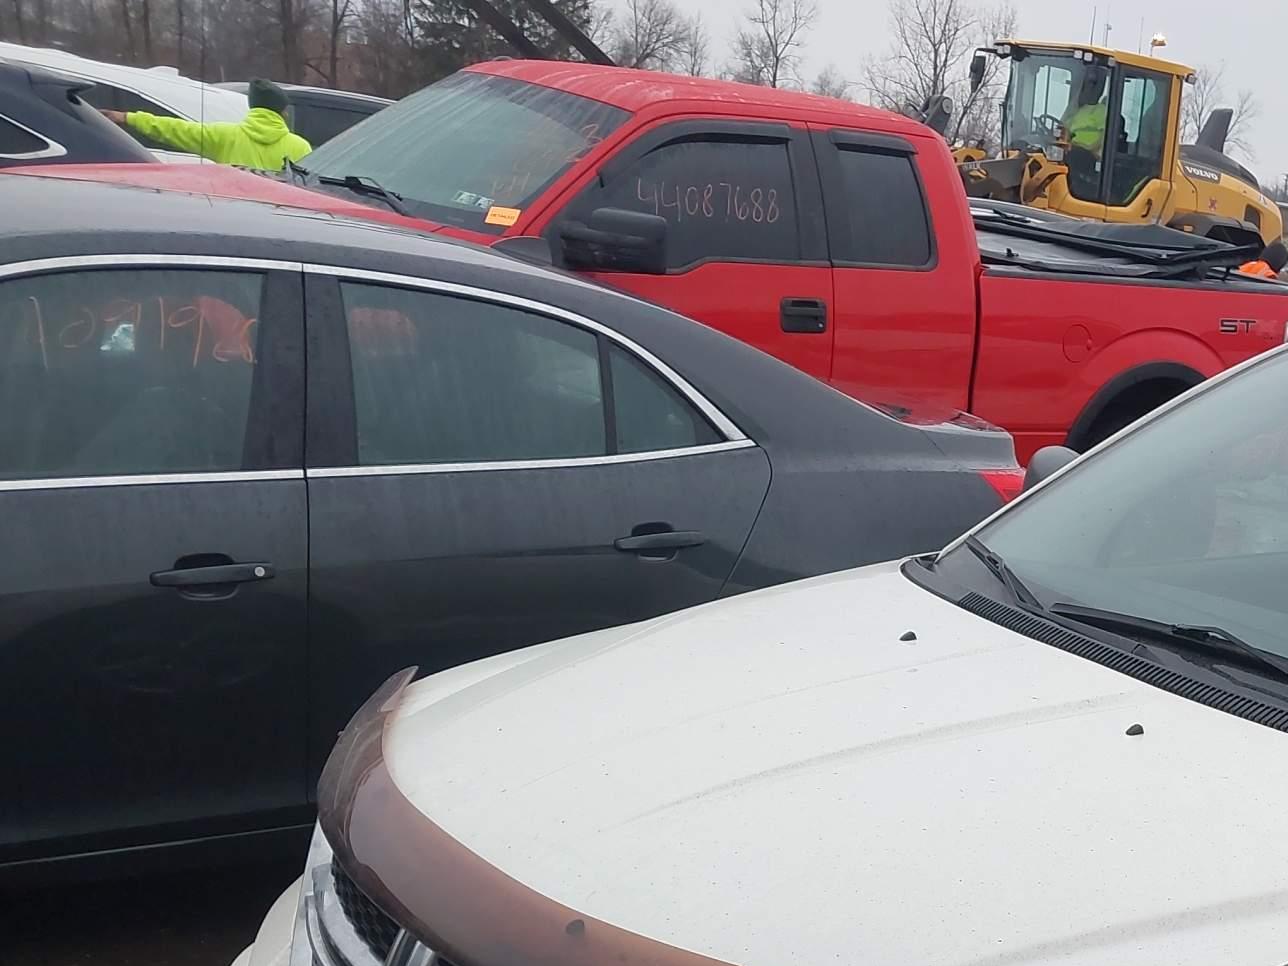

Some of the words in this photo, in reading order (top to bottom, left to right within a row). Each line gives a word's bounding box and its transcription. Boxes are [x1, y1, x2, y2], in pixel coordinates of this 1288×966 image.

[1184, 165, 1219, 180] VOLVO
[636, 176, 780, 223] 44087688
[1219, 318, 1257, 334] ST
